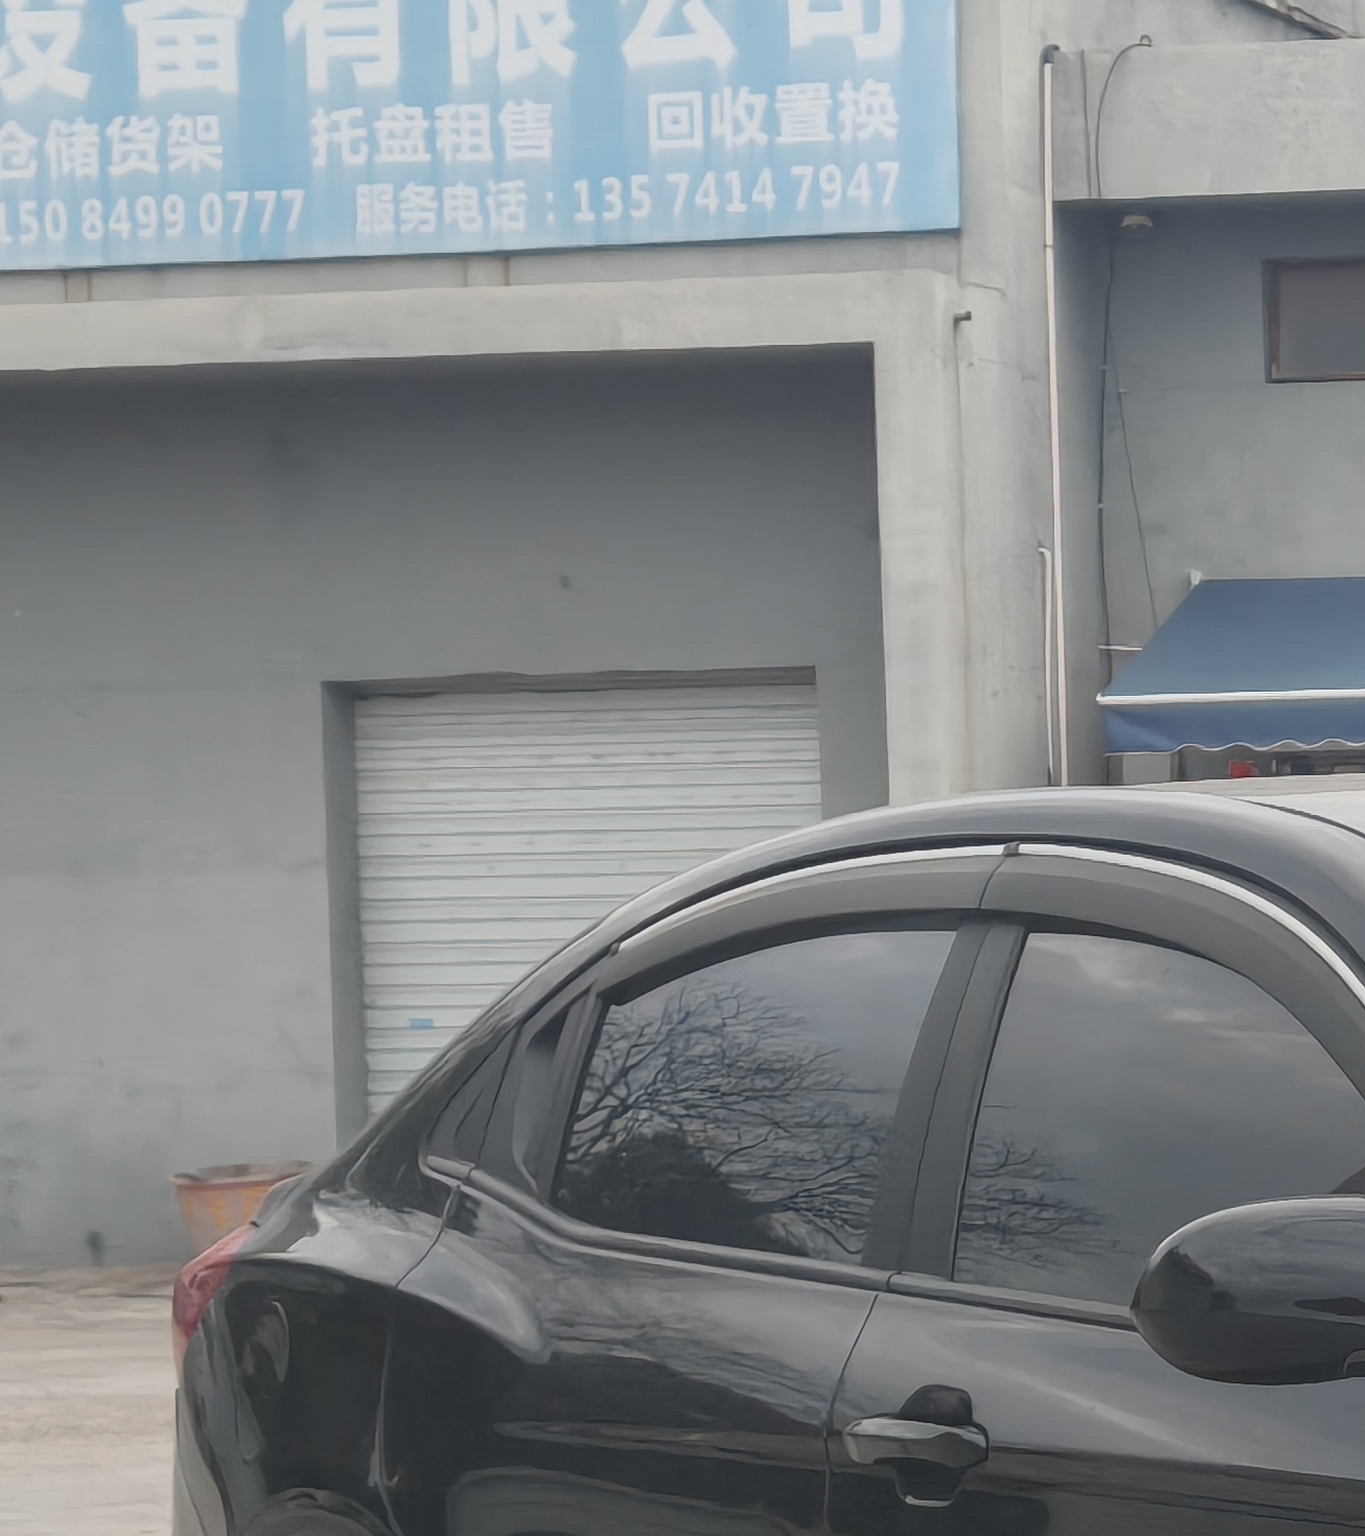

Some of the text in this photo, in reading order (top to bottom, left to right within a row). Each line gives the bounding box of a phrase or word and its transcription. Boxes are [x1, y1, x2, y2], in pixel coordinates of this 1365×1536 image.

[0, 79, 899, 179] 仓储货架 托盘租售 回收置换
[81, 194, 185, 241] 8499
[200, 189, 305, 236] 0777
[573, 175, 651, 222] 135
[666, 168, 777, 215] 7414
[790, 161, 900, 211] 7947
